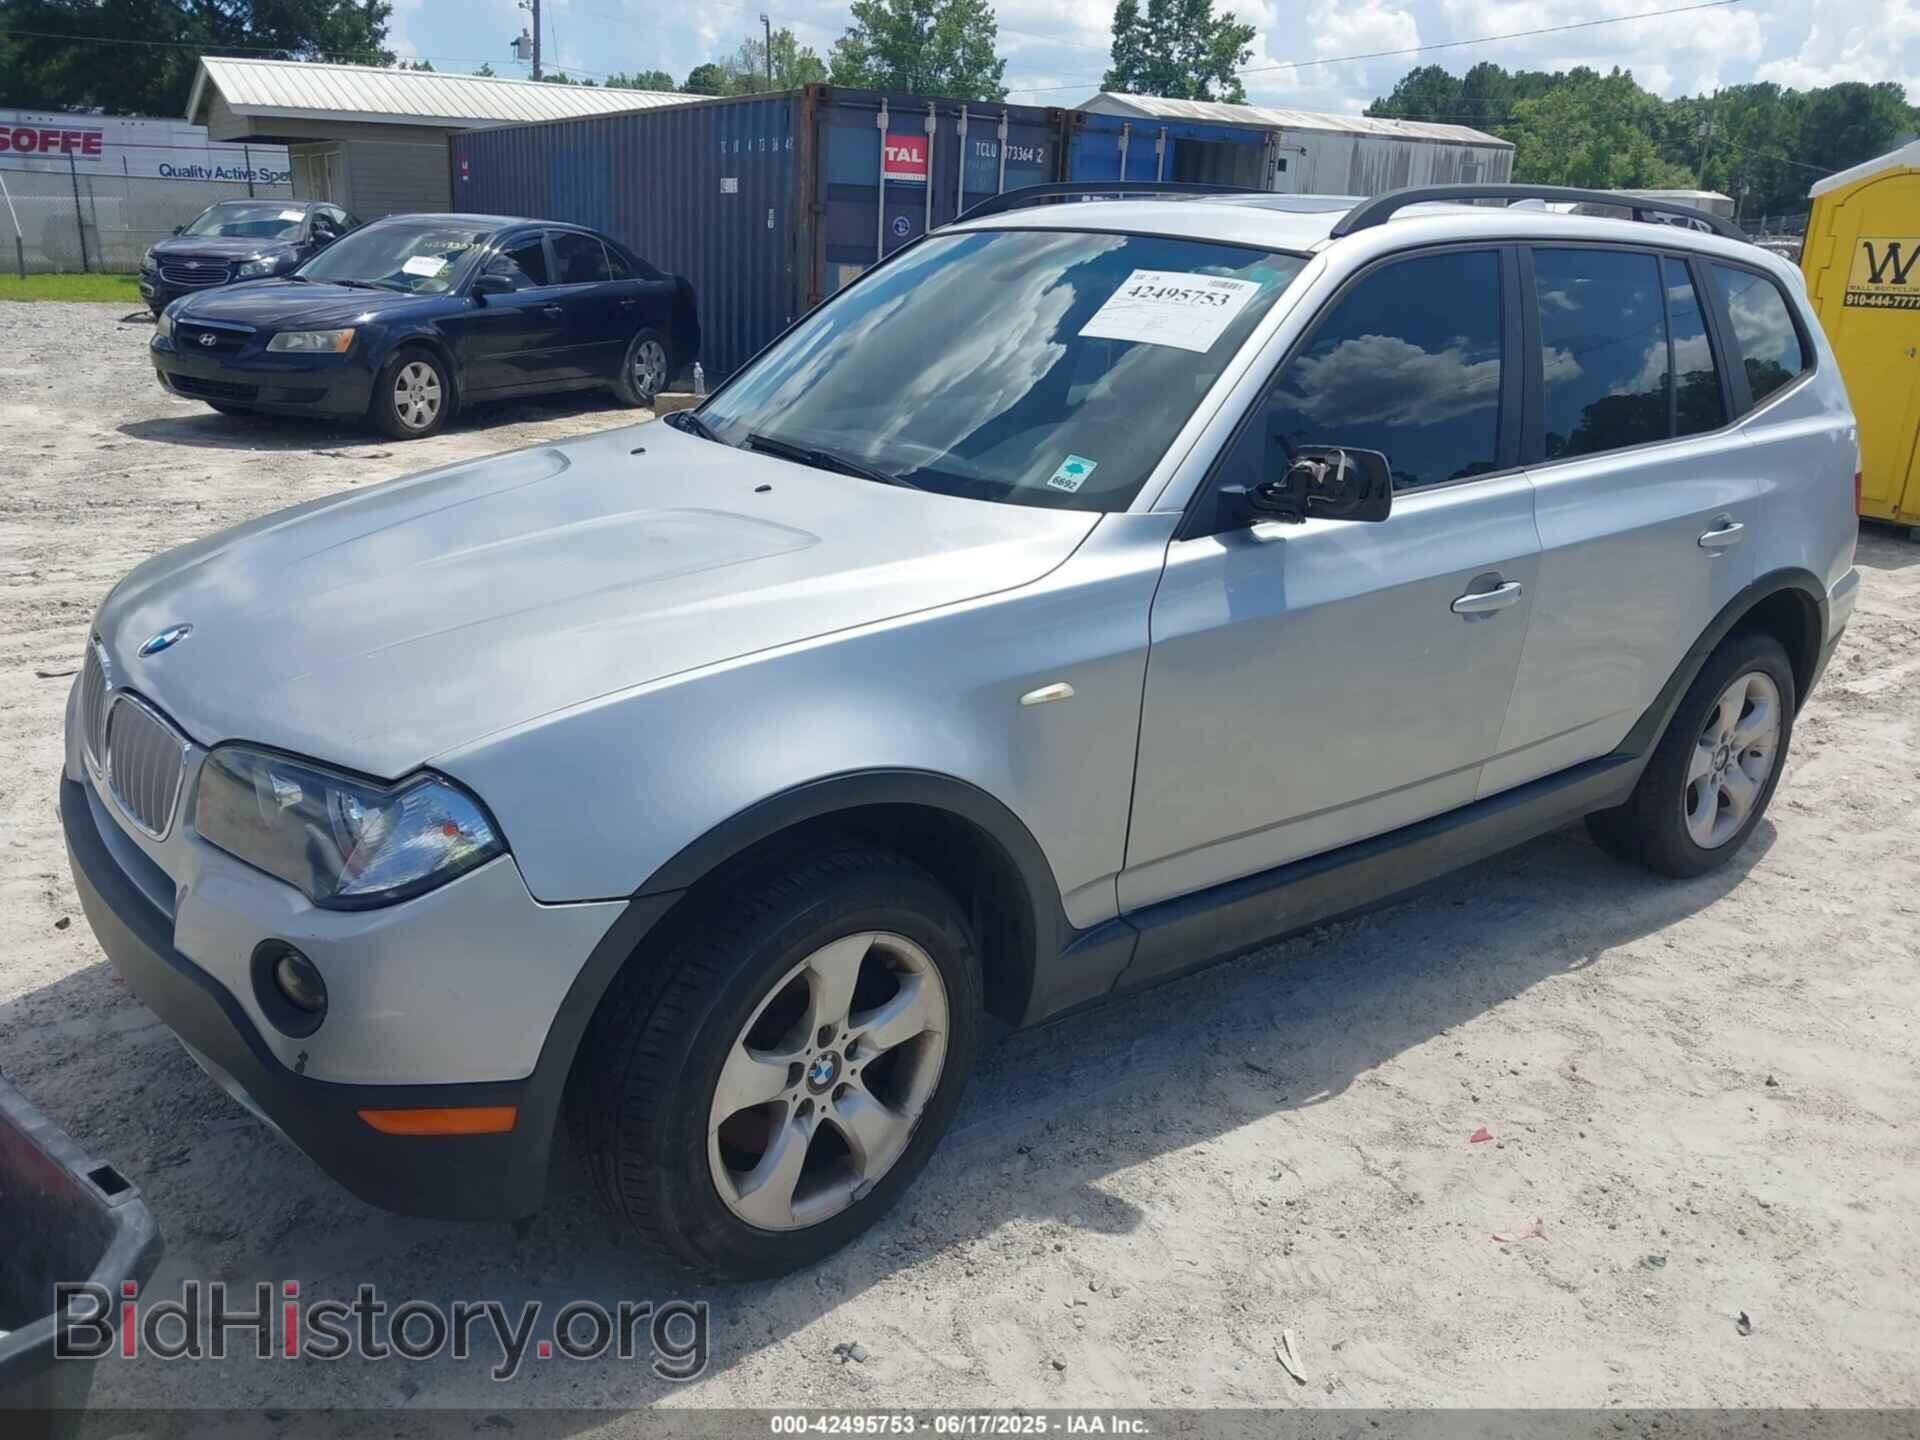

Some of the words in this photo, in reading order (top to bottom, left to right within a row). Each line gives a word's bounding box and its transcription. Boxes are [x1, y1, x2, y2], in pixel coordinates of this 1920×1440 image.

[885, 147, 923, 163] TAL
[975, 142, 997, 158] TCLU
[1036, 147, 1045, 163] 2
[159, 163, 212, 179] Quality
[215, 166, 257, 180] Active
[1863, 241, 1920, 285] W
[1127, 284, 1231, 307] 42495753
